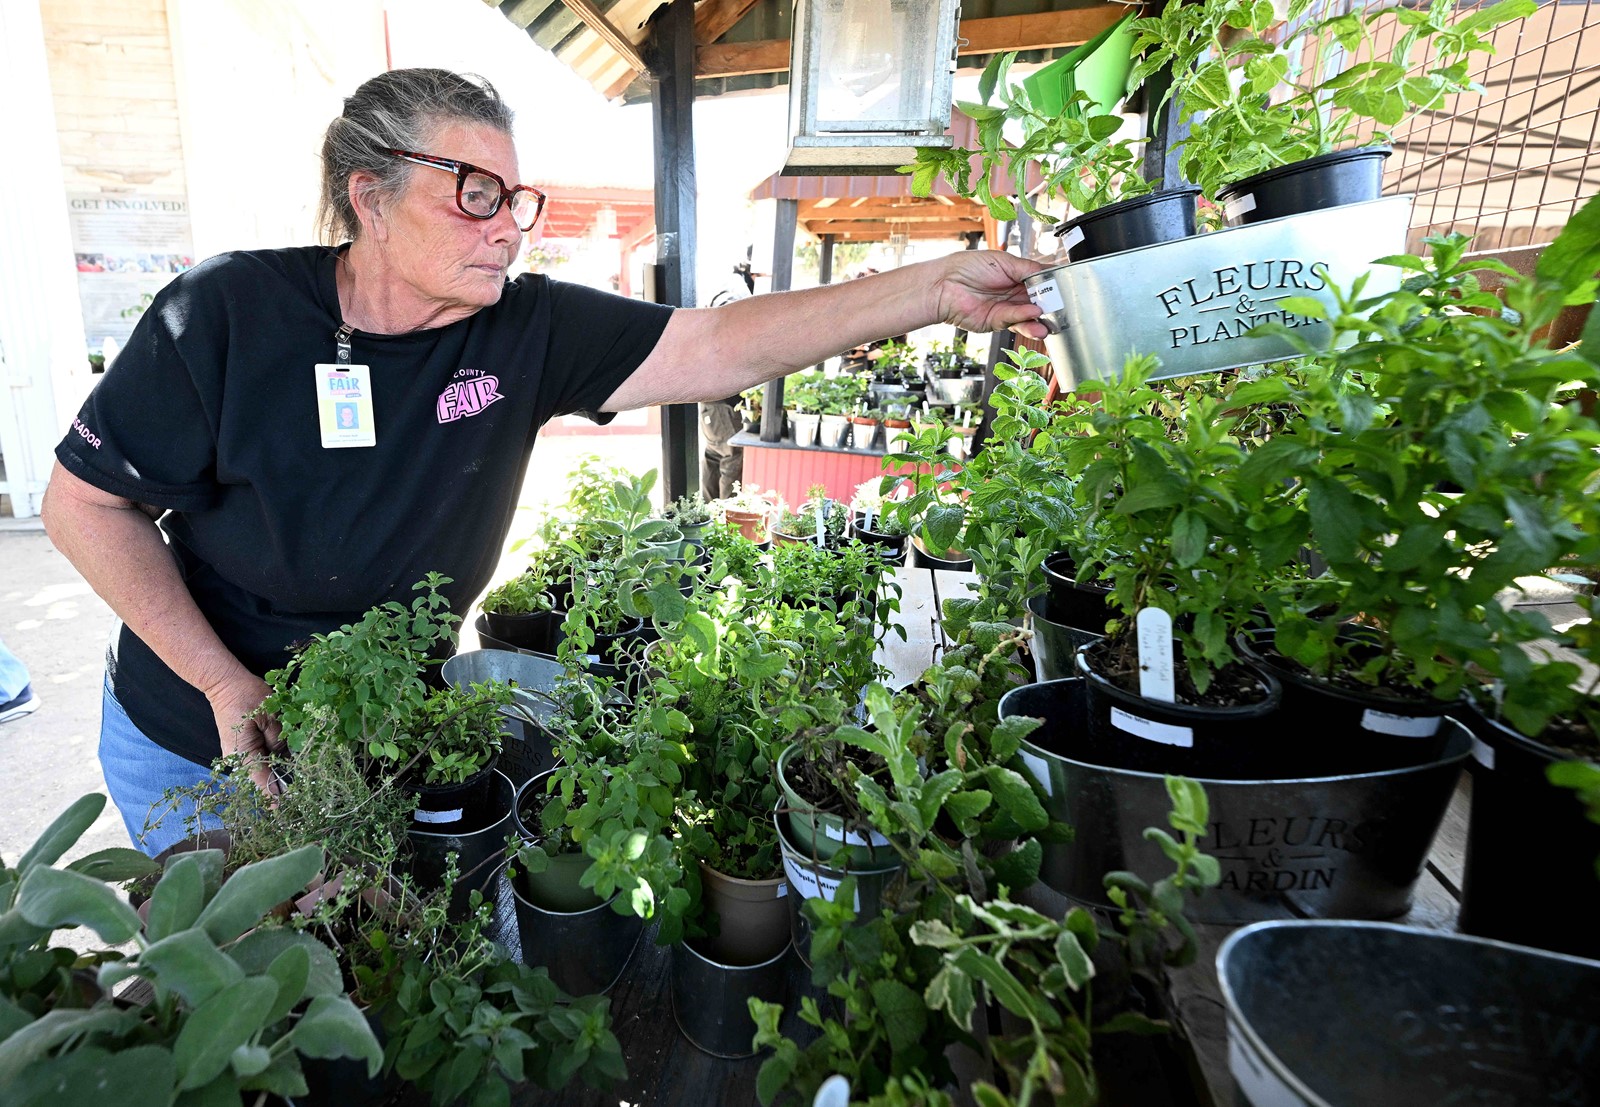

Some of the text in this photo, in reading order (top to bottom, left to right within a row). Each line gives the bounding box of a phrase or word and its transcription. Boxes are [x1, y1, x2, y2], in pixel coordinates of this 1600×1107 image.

[70, 199, 188, 212] GET INVOLVED!
[1155, 259, 1331, 319] FLEURS
[1235, 292, 1256, 315] &
[453, 368, 486, 378] COUNTY
[437, 377, 502, 423] FAIR
[1178, 815, 1375, 853] LEURS
[1261, 847, 1284, 868] &
[1216, 867, 1337, 891] ARDIN
